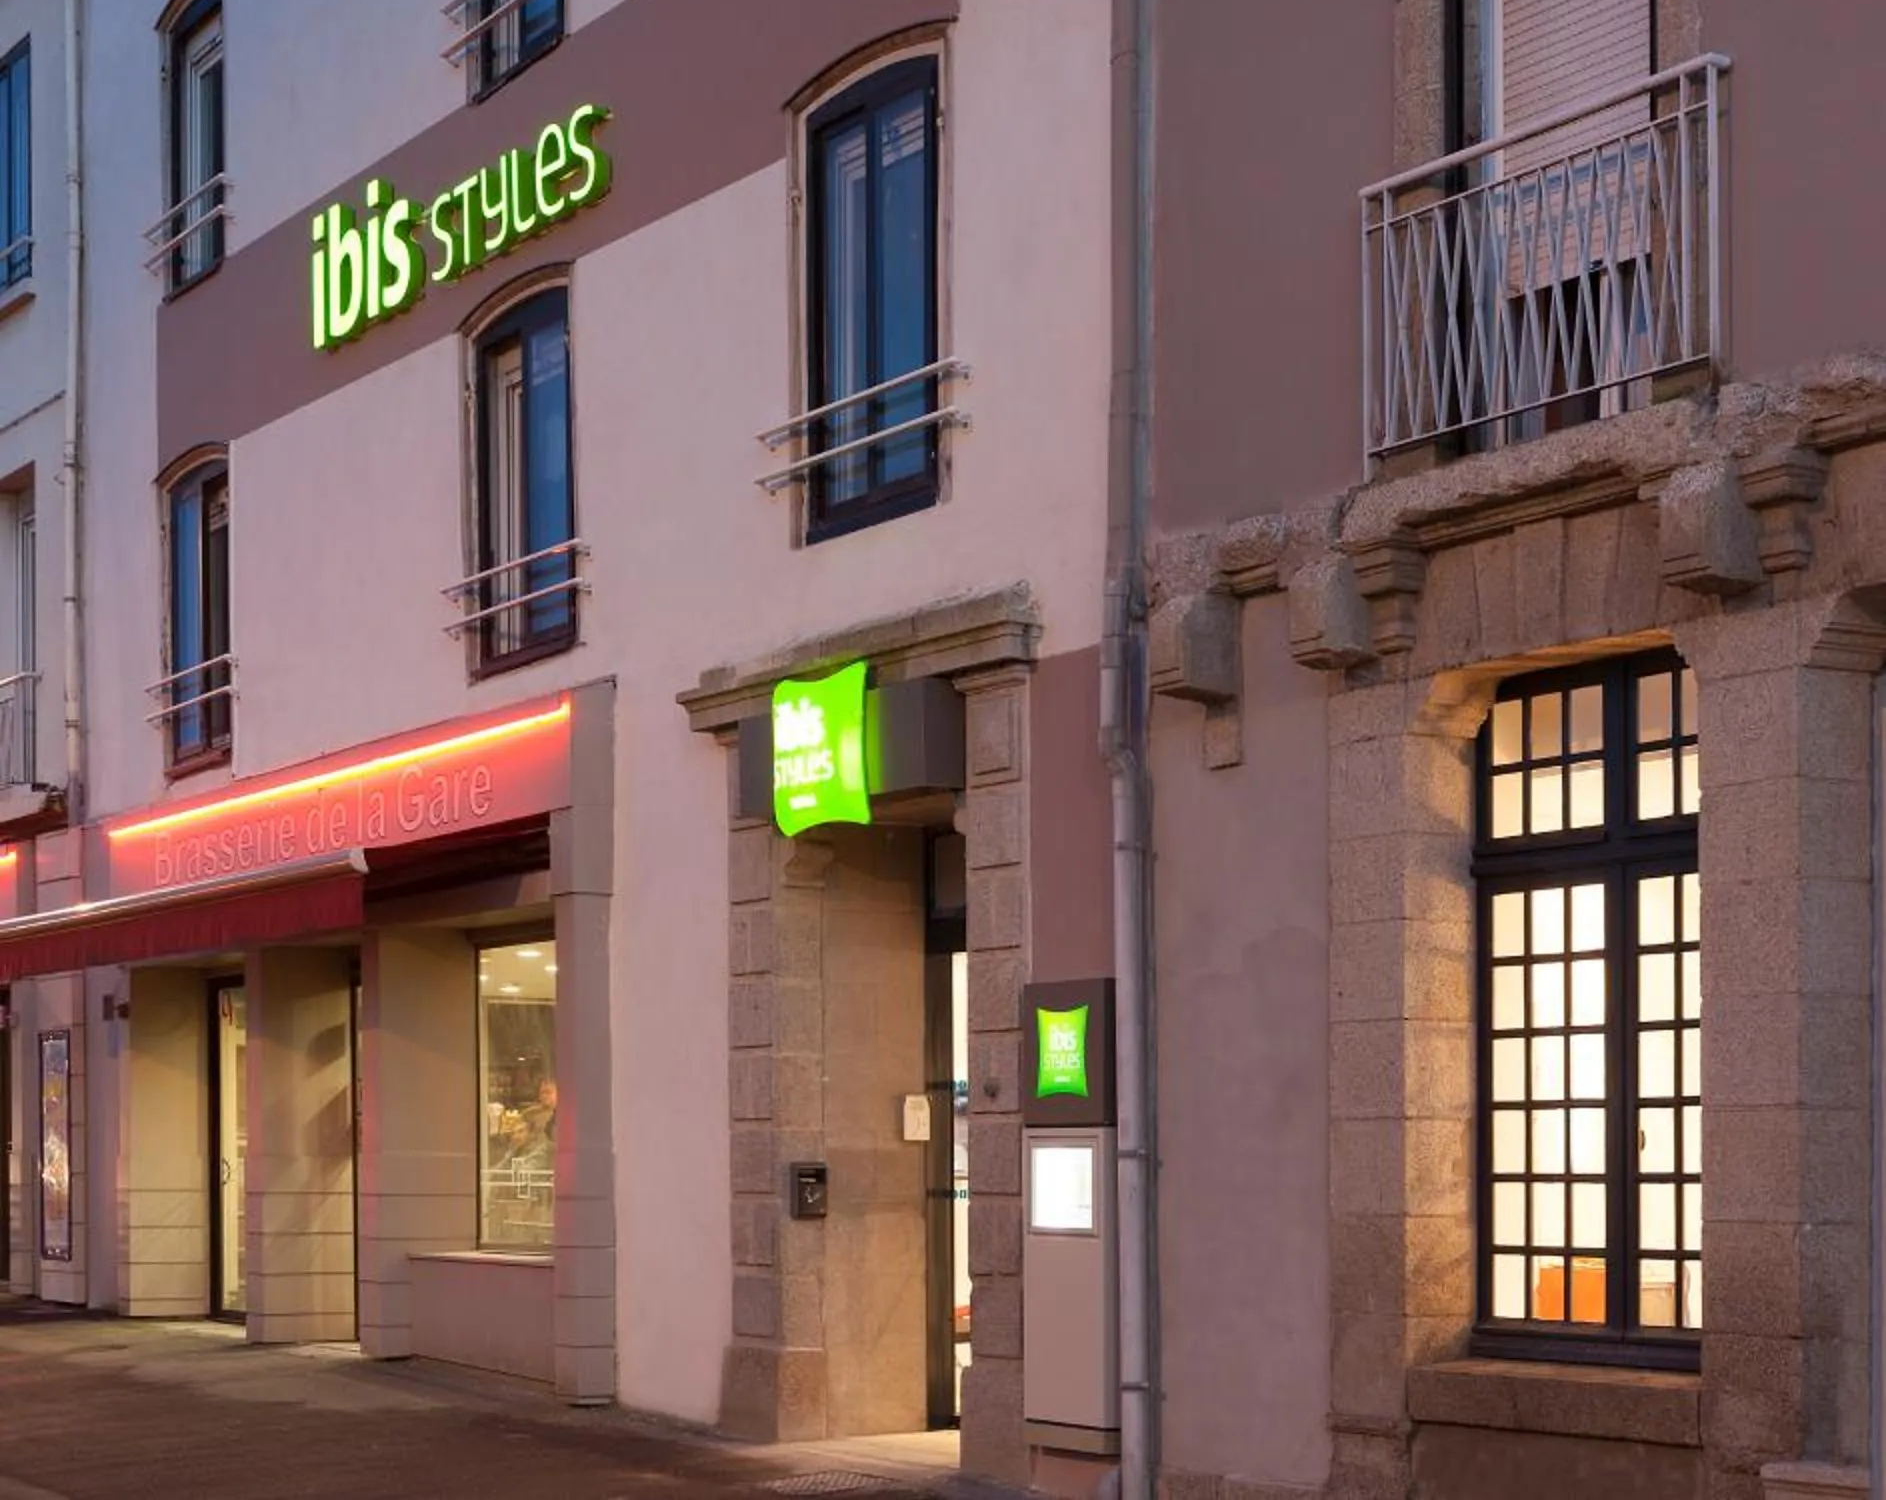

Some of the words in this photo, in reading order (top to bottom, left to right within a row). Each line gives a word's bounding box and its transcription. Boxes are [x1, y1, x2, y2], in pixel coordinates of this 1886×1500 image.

[311, 178, 416, 350] ibis
[154, 801, 296, 886] Brasserie
[306, 787, 347, 853] de
[357, 774, 386, 843] la
[397, 764, 492, 832] Gare
